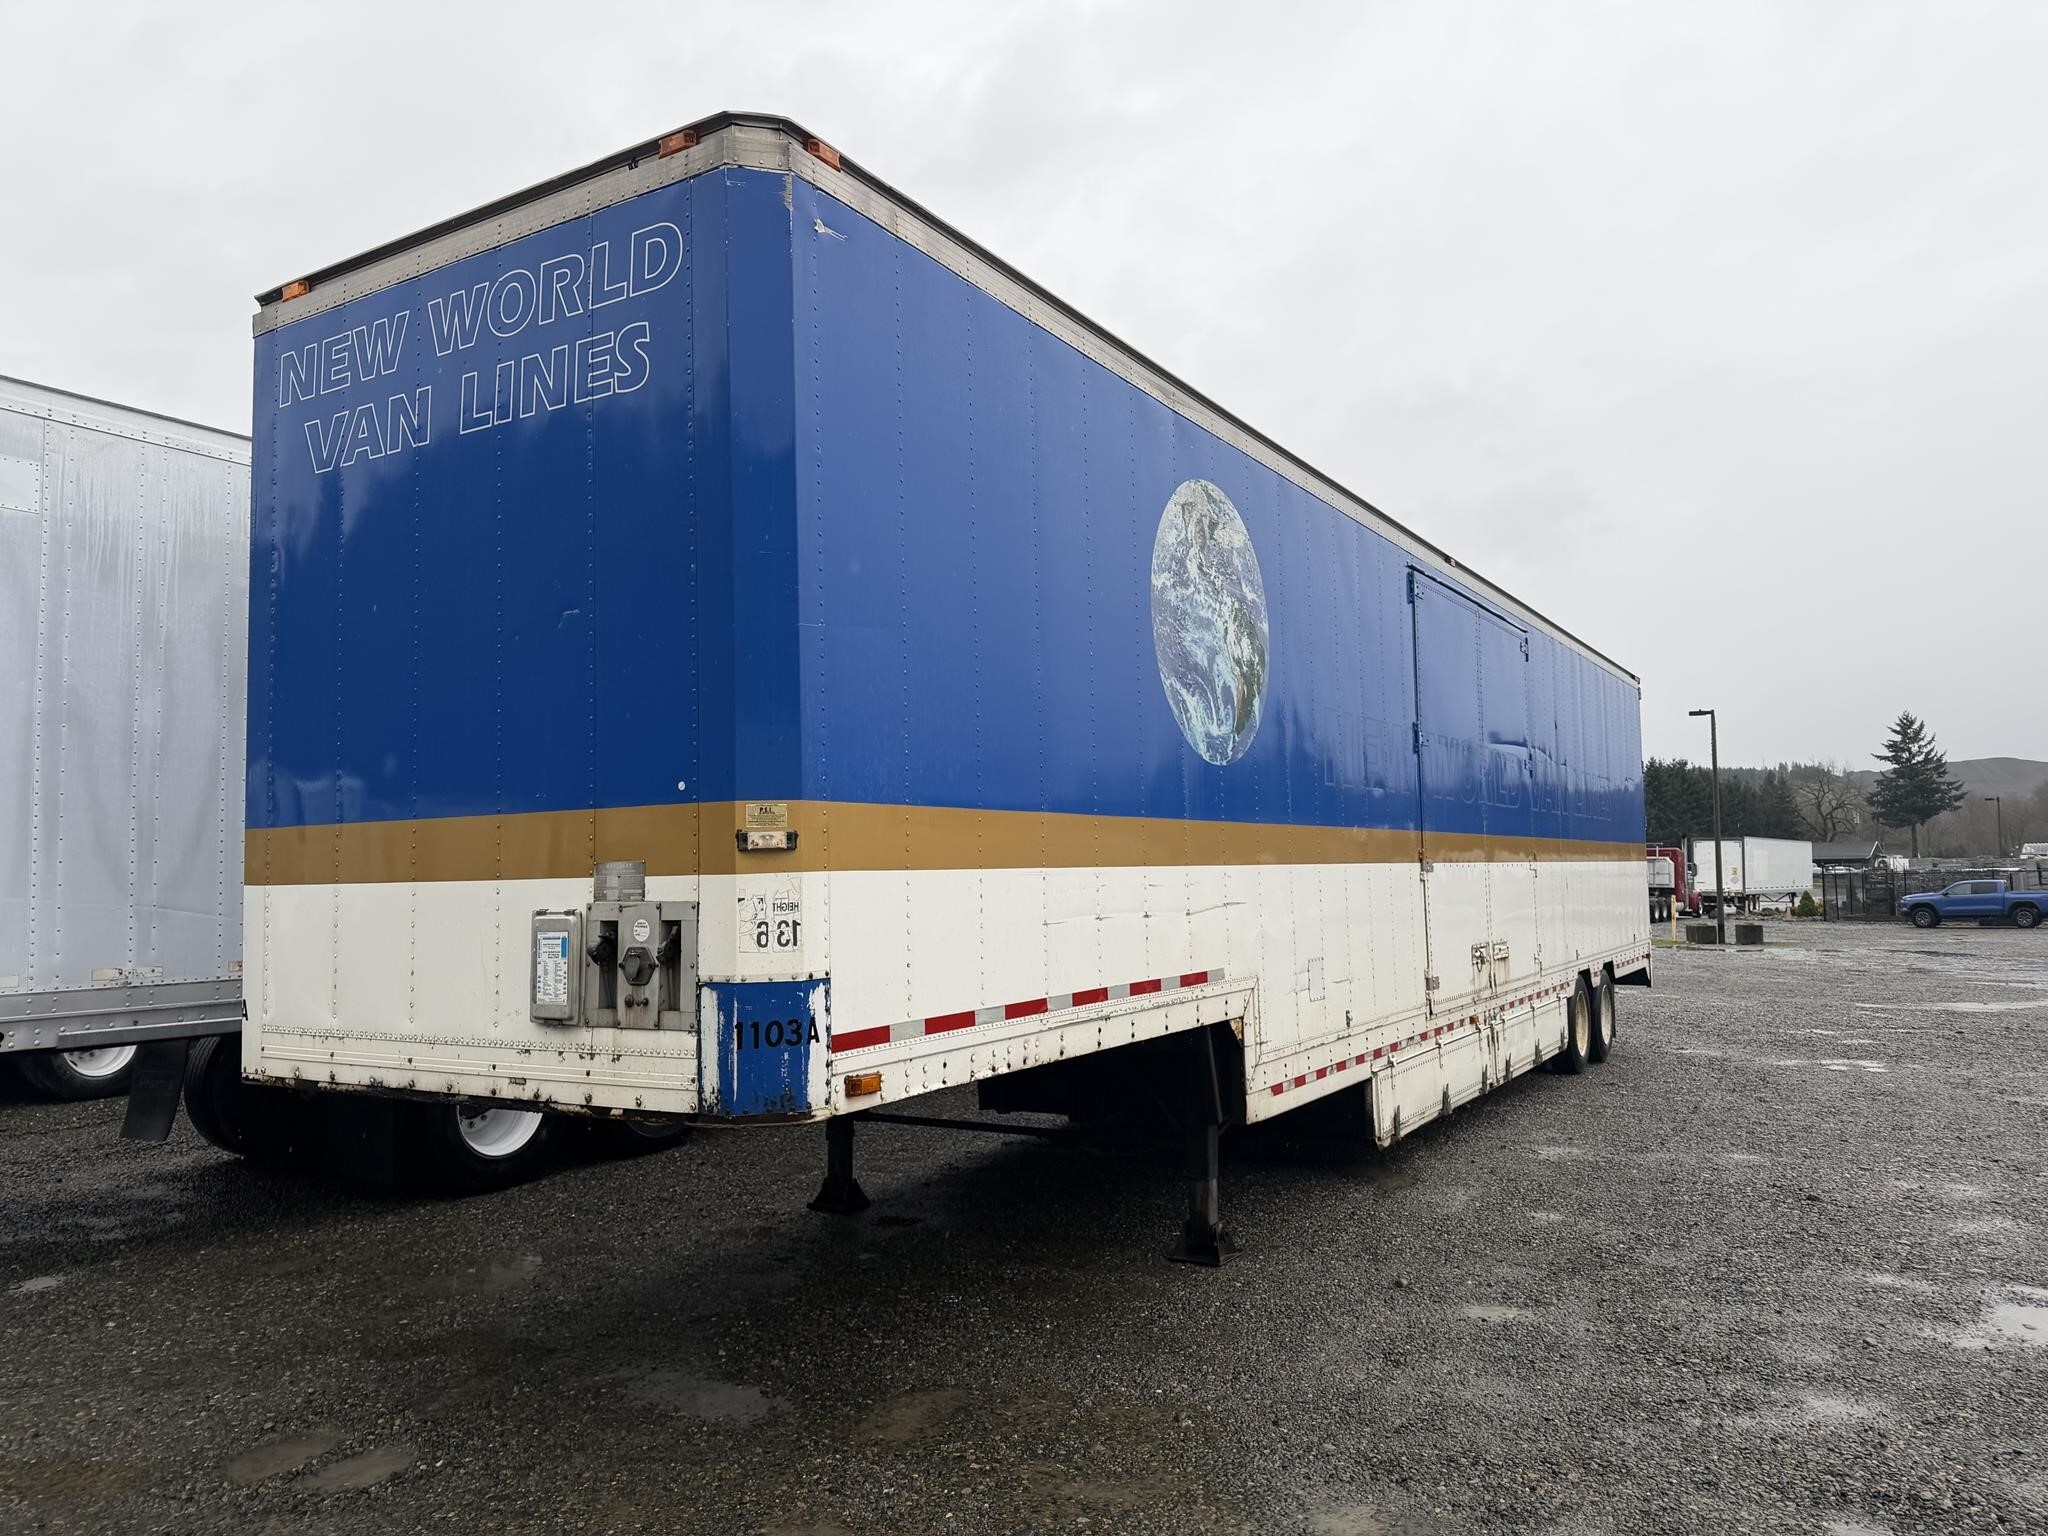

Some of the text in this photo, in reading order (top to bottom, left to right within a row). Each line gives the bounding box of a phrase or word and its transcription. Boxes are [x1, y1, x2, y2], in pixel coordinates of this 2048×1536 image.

[279, 222, 684, 409] NEW WORLD
[304, 321, 651, 474] VAN LINES
[735, 1016, 820, 1050] 1103A
